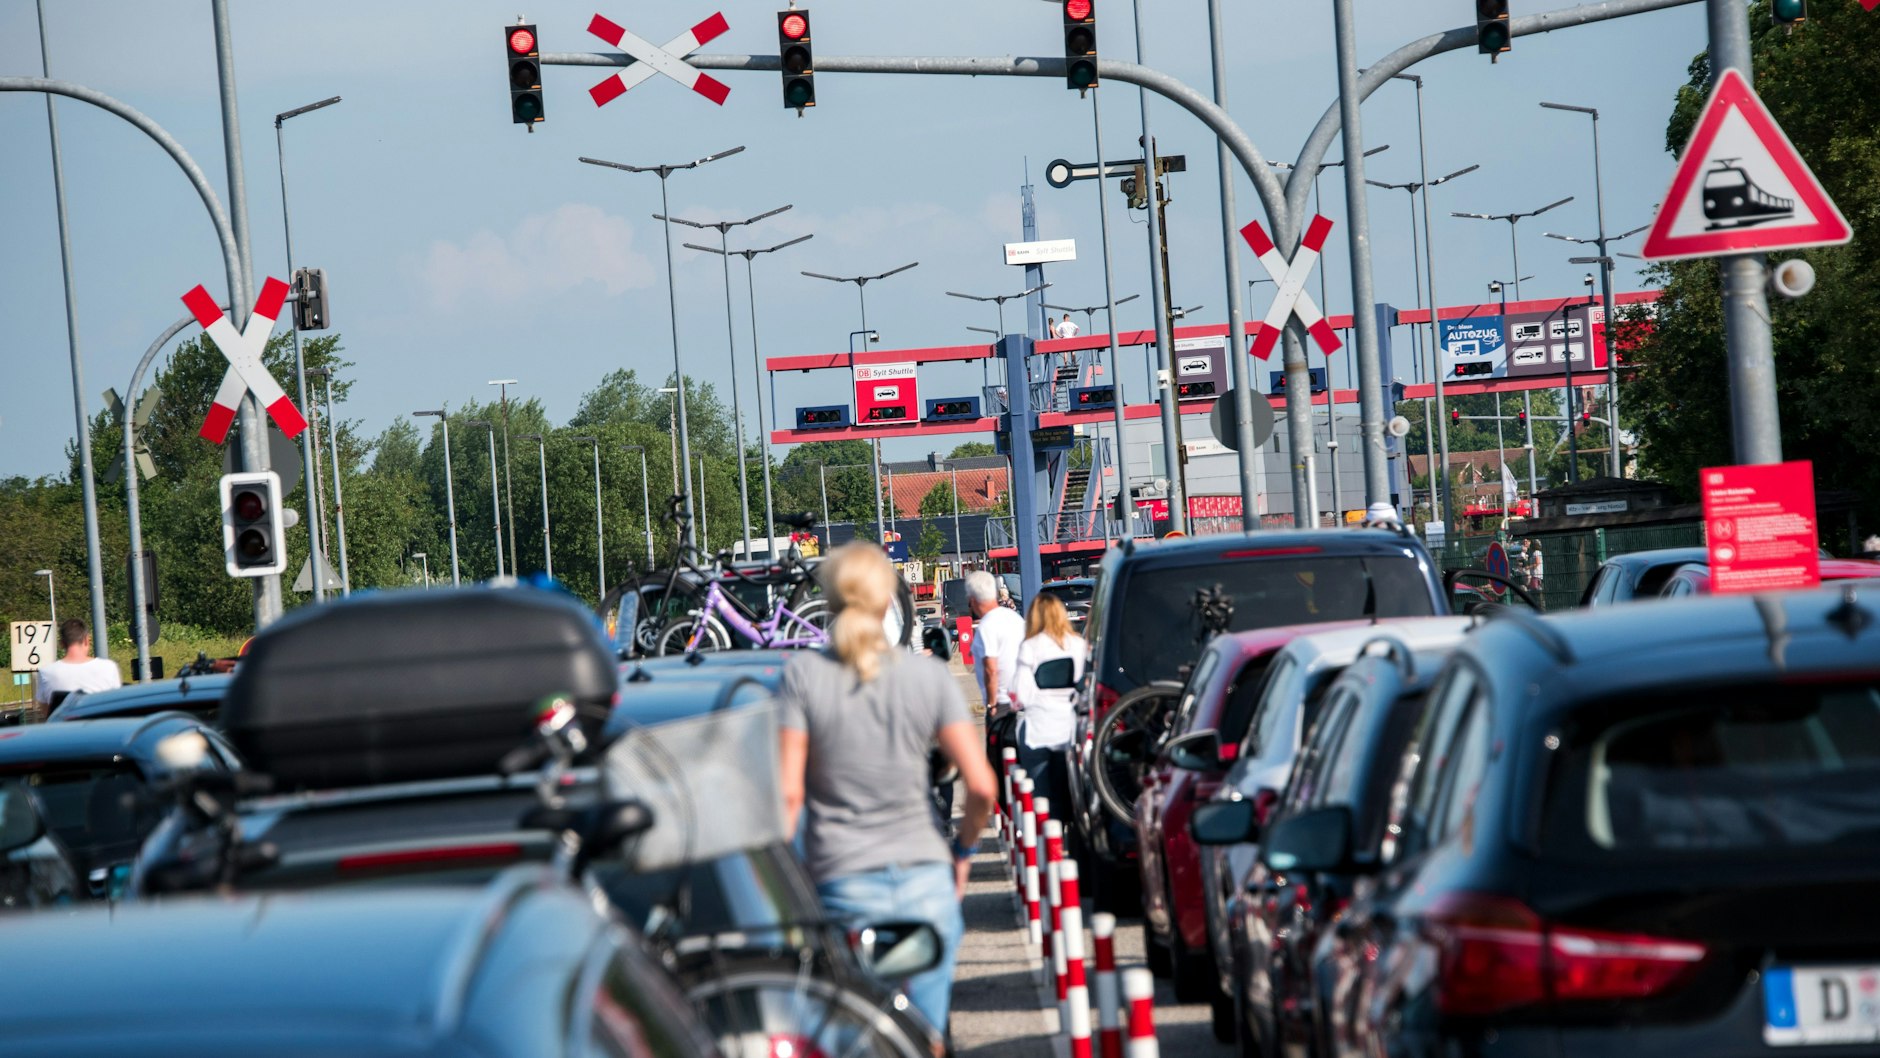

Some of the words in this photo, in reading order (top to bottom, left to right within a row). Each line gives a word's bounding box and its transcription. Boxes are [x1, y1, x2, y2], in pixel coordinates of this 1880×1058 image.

[1050, 245, 1074, 254] Shuttle
[1448, 329, 1498, 341] AUTOZUG
[858, 369, 871, 378] DB
[888, 368, 914, 376] Shuttle
[905, 563, 920, 572] 197
[911, 573, 917, 581] 8
[15, 624, 52, 644] 197
[28, 646, 40, 665] 6
[1821, 979, 1850, 1021] D
